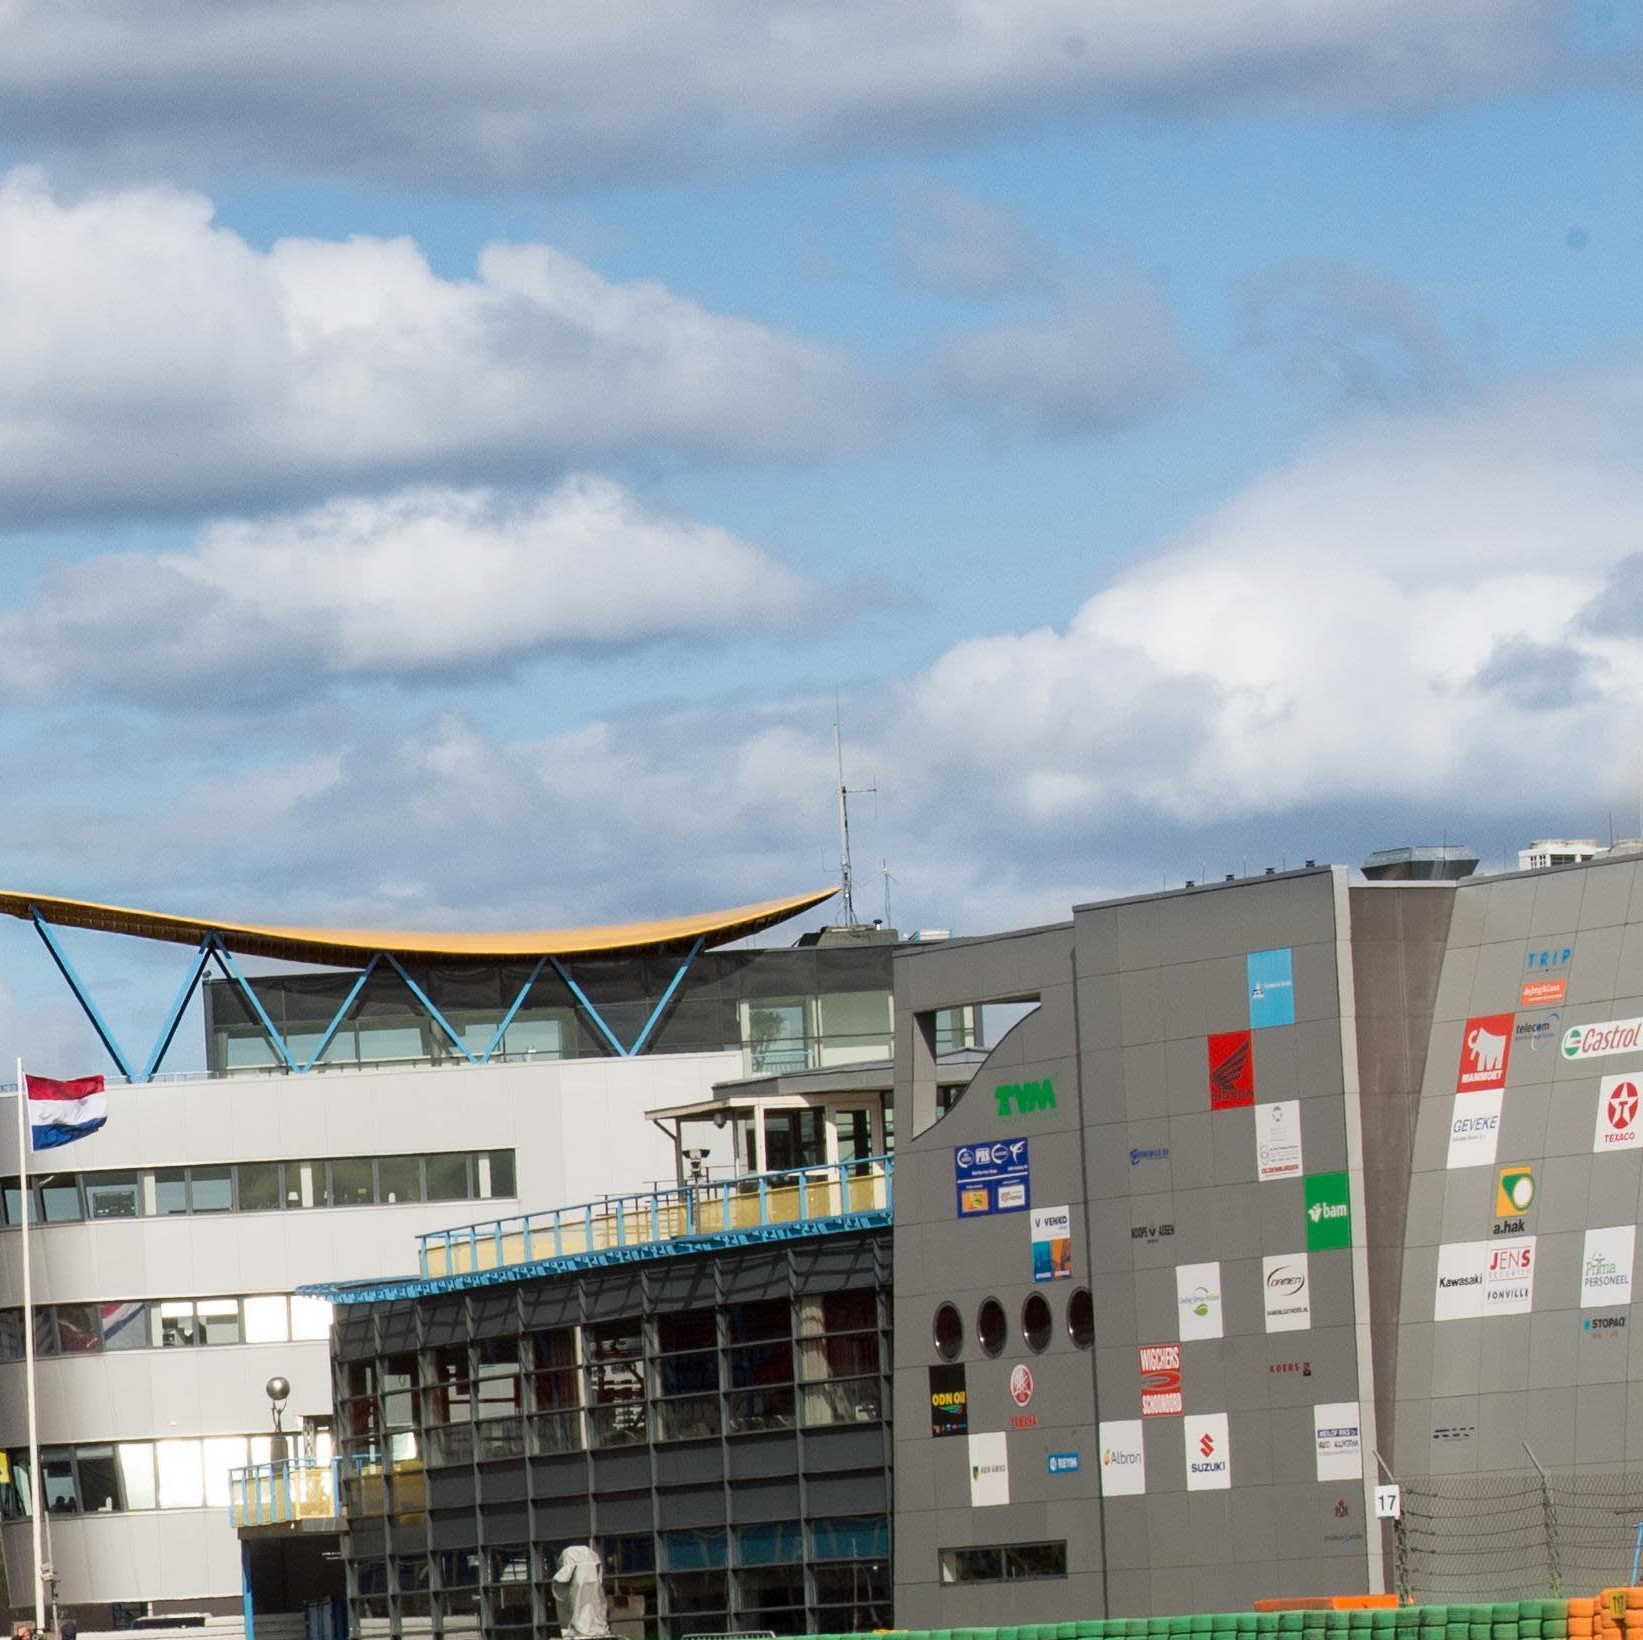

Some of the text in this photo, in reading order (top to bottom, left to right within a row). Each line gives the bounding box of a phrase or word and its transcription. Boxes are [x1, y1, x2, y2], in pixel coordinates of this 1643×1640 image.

[1527, 949, 1572, 968] TRIP
[1516, 1021, 1550, 1033] telecom
[1582, 1023, 1642, 1054] Castrol
[1461, 1070, 1504, 1083] MAMMOET
[994, 1079, 1056, 1116] TVM
[1453, 1116, 1498, 1133] GEVEKE
[1605, 1133, 1635, 1143] TEXACO
[1323, 1202, 1347, 1218] bam
[1493, 1219, 1525, 1234] a.hak
[1490, 1249, 1531, 1270] JENS
[1586, 1262, 1617, 1276] Prima
[1440, 1273, 1482, 1288] Kawasaki
[1584, 1275, 1629, 1287] PERSONEEL
[932, 1393, 953, 1406] ODN
[1111, 1452, 1141, 1464] Albron
[1191, 1461, 1225, 1473] SUZUKI
[1378, 1495, 1397, 1510] 17
